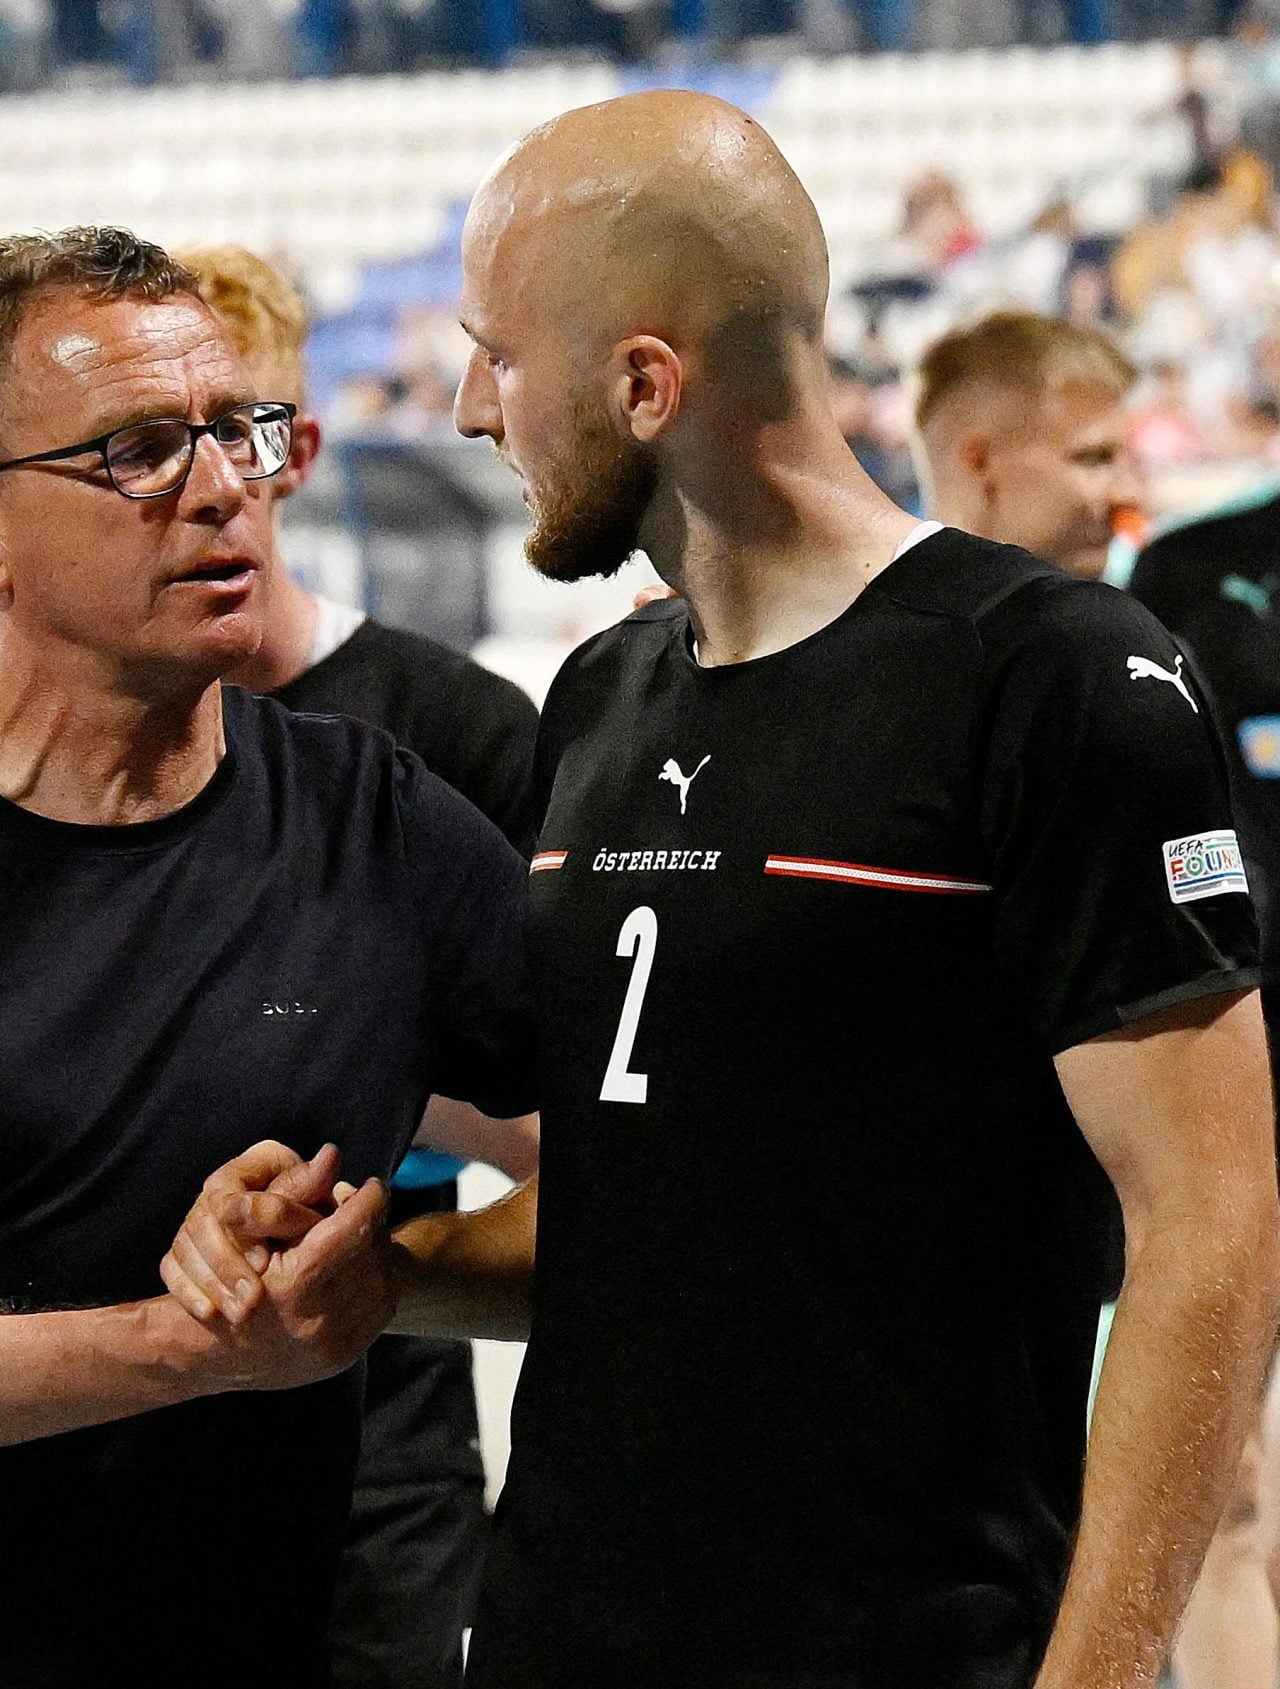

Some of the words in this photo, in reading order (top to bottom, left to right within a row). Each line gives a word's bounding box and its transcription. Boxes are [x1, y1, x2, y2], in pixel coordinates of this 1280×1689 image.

[593, 847, 722, 872] ÖSTERREICH
[1169, 840, 1203, 857] UEFA
[599, 905, 658, 1104] 2
